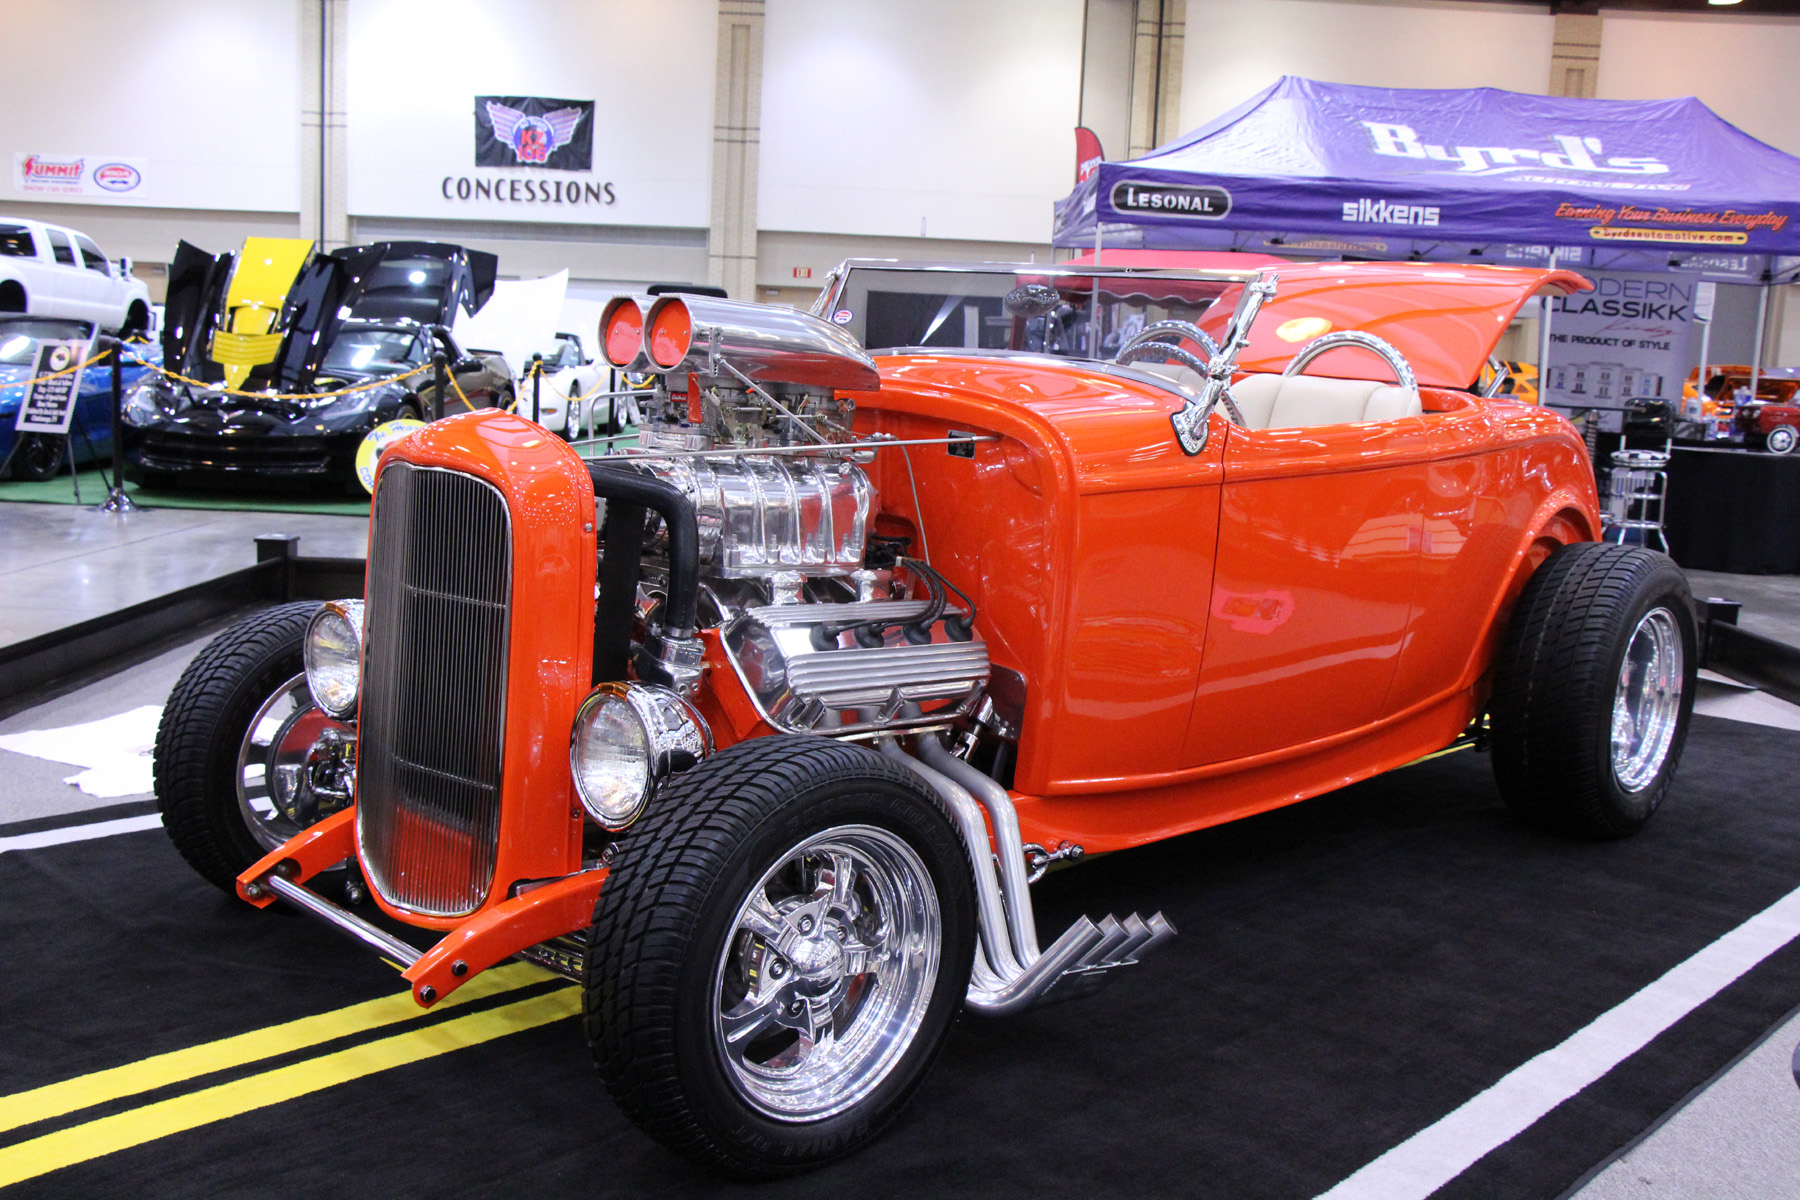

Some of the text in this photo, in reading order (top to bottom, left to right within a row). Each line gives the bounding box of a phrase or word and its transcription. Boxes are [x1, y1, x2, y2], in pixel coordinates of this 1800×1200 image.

[521, 130, 545, 145] KZ
[1362, 121, 1670, 175] Byrd's
[518, 144, 547, 162] 106
[442, 177, 616, 205] CONCESSIONS
[1127, 187, 1214, 212] LESONAL
[1342, 199, 1440, 226] sikkens
[1554, 202, 1788, 231] Earning Your Business Everyday
[1603, 228, 1734, 242] byrdsautomotive.com
[1577, 276, 1692, 302] ODERN
[1541, 296, 1689, 322] CLASSIKK
[1571, 335, 1619, 347] PRODUCT
[1622, 338, 1636, 347] OF
[1638, 340, 1671, 350] STYLE
